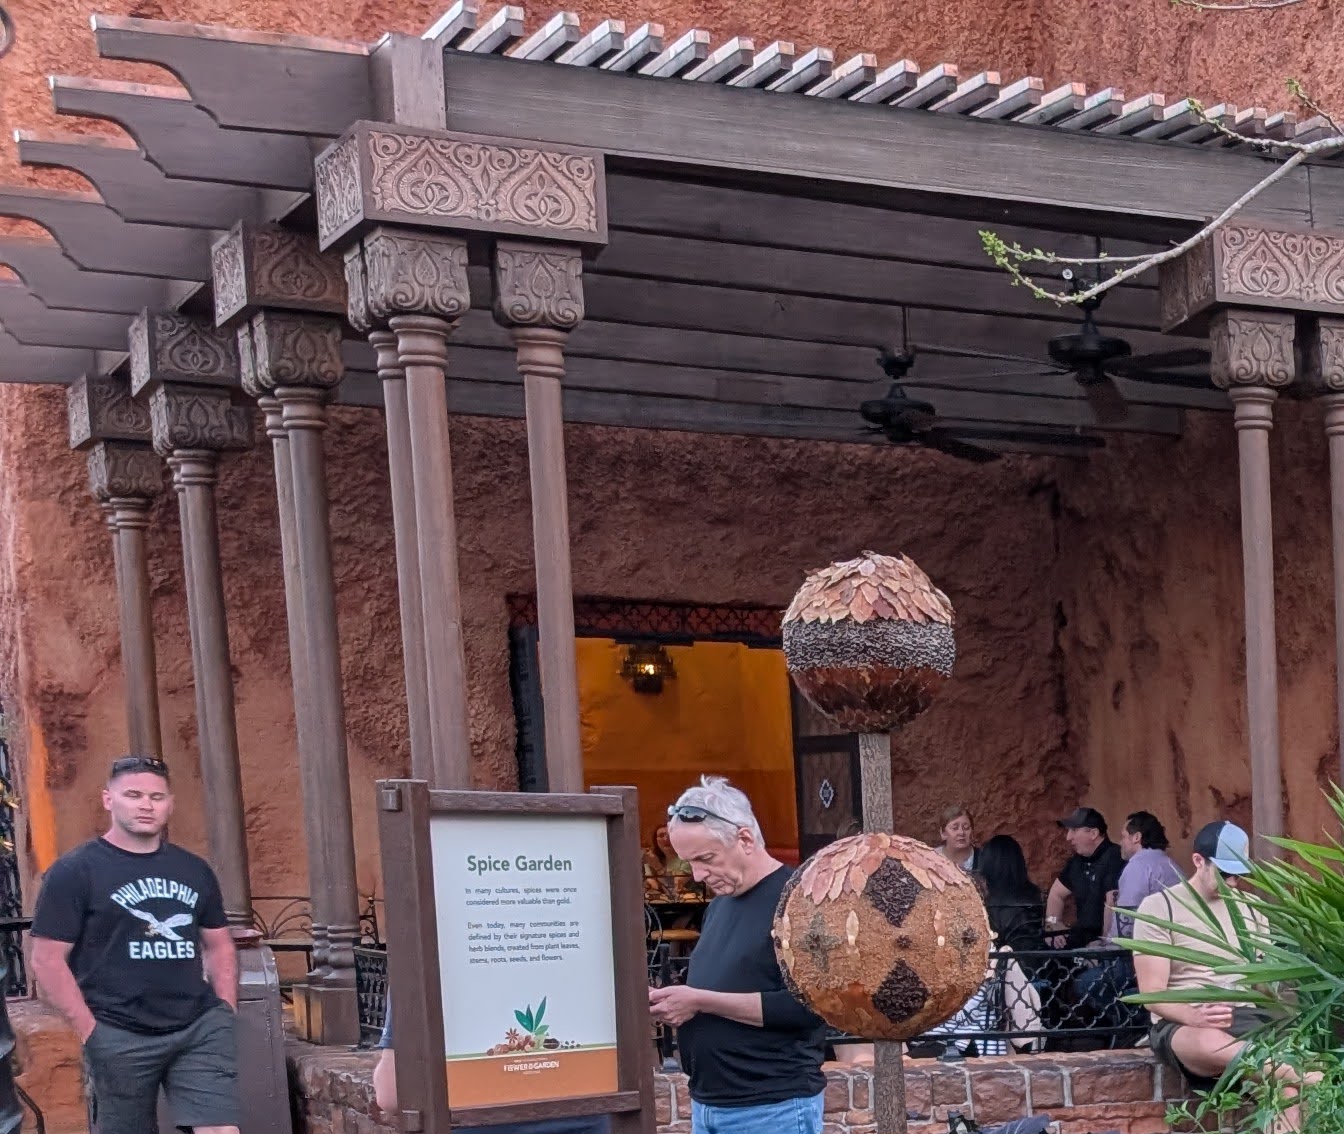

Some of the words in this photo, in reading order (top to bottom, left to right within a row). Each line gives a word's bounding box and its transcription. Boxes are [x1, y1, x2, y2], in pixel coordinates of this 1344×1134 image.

[467, 855, 510, 876] Spice
[515, 854, 573, 871] Garden
[110, 877, 199, 910] PHILADELPHIA
[129, 941, 195, 959] EAGLES
